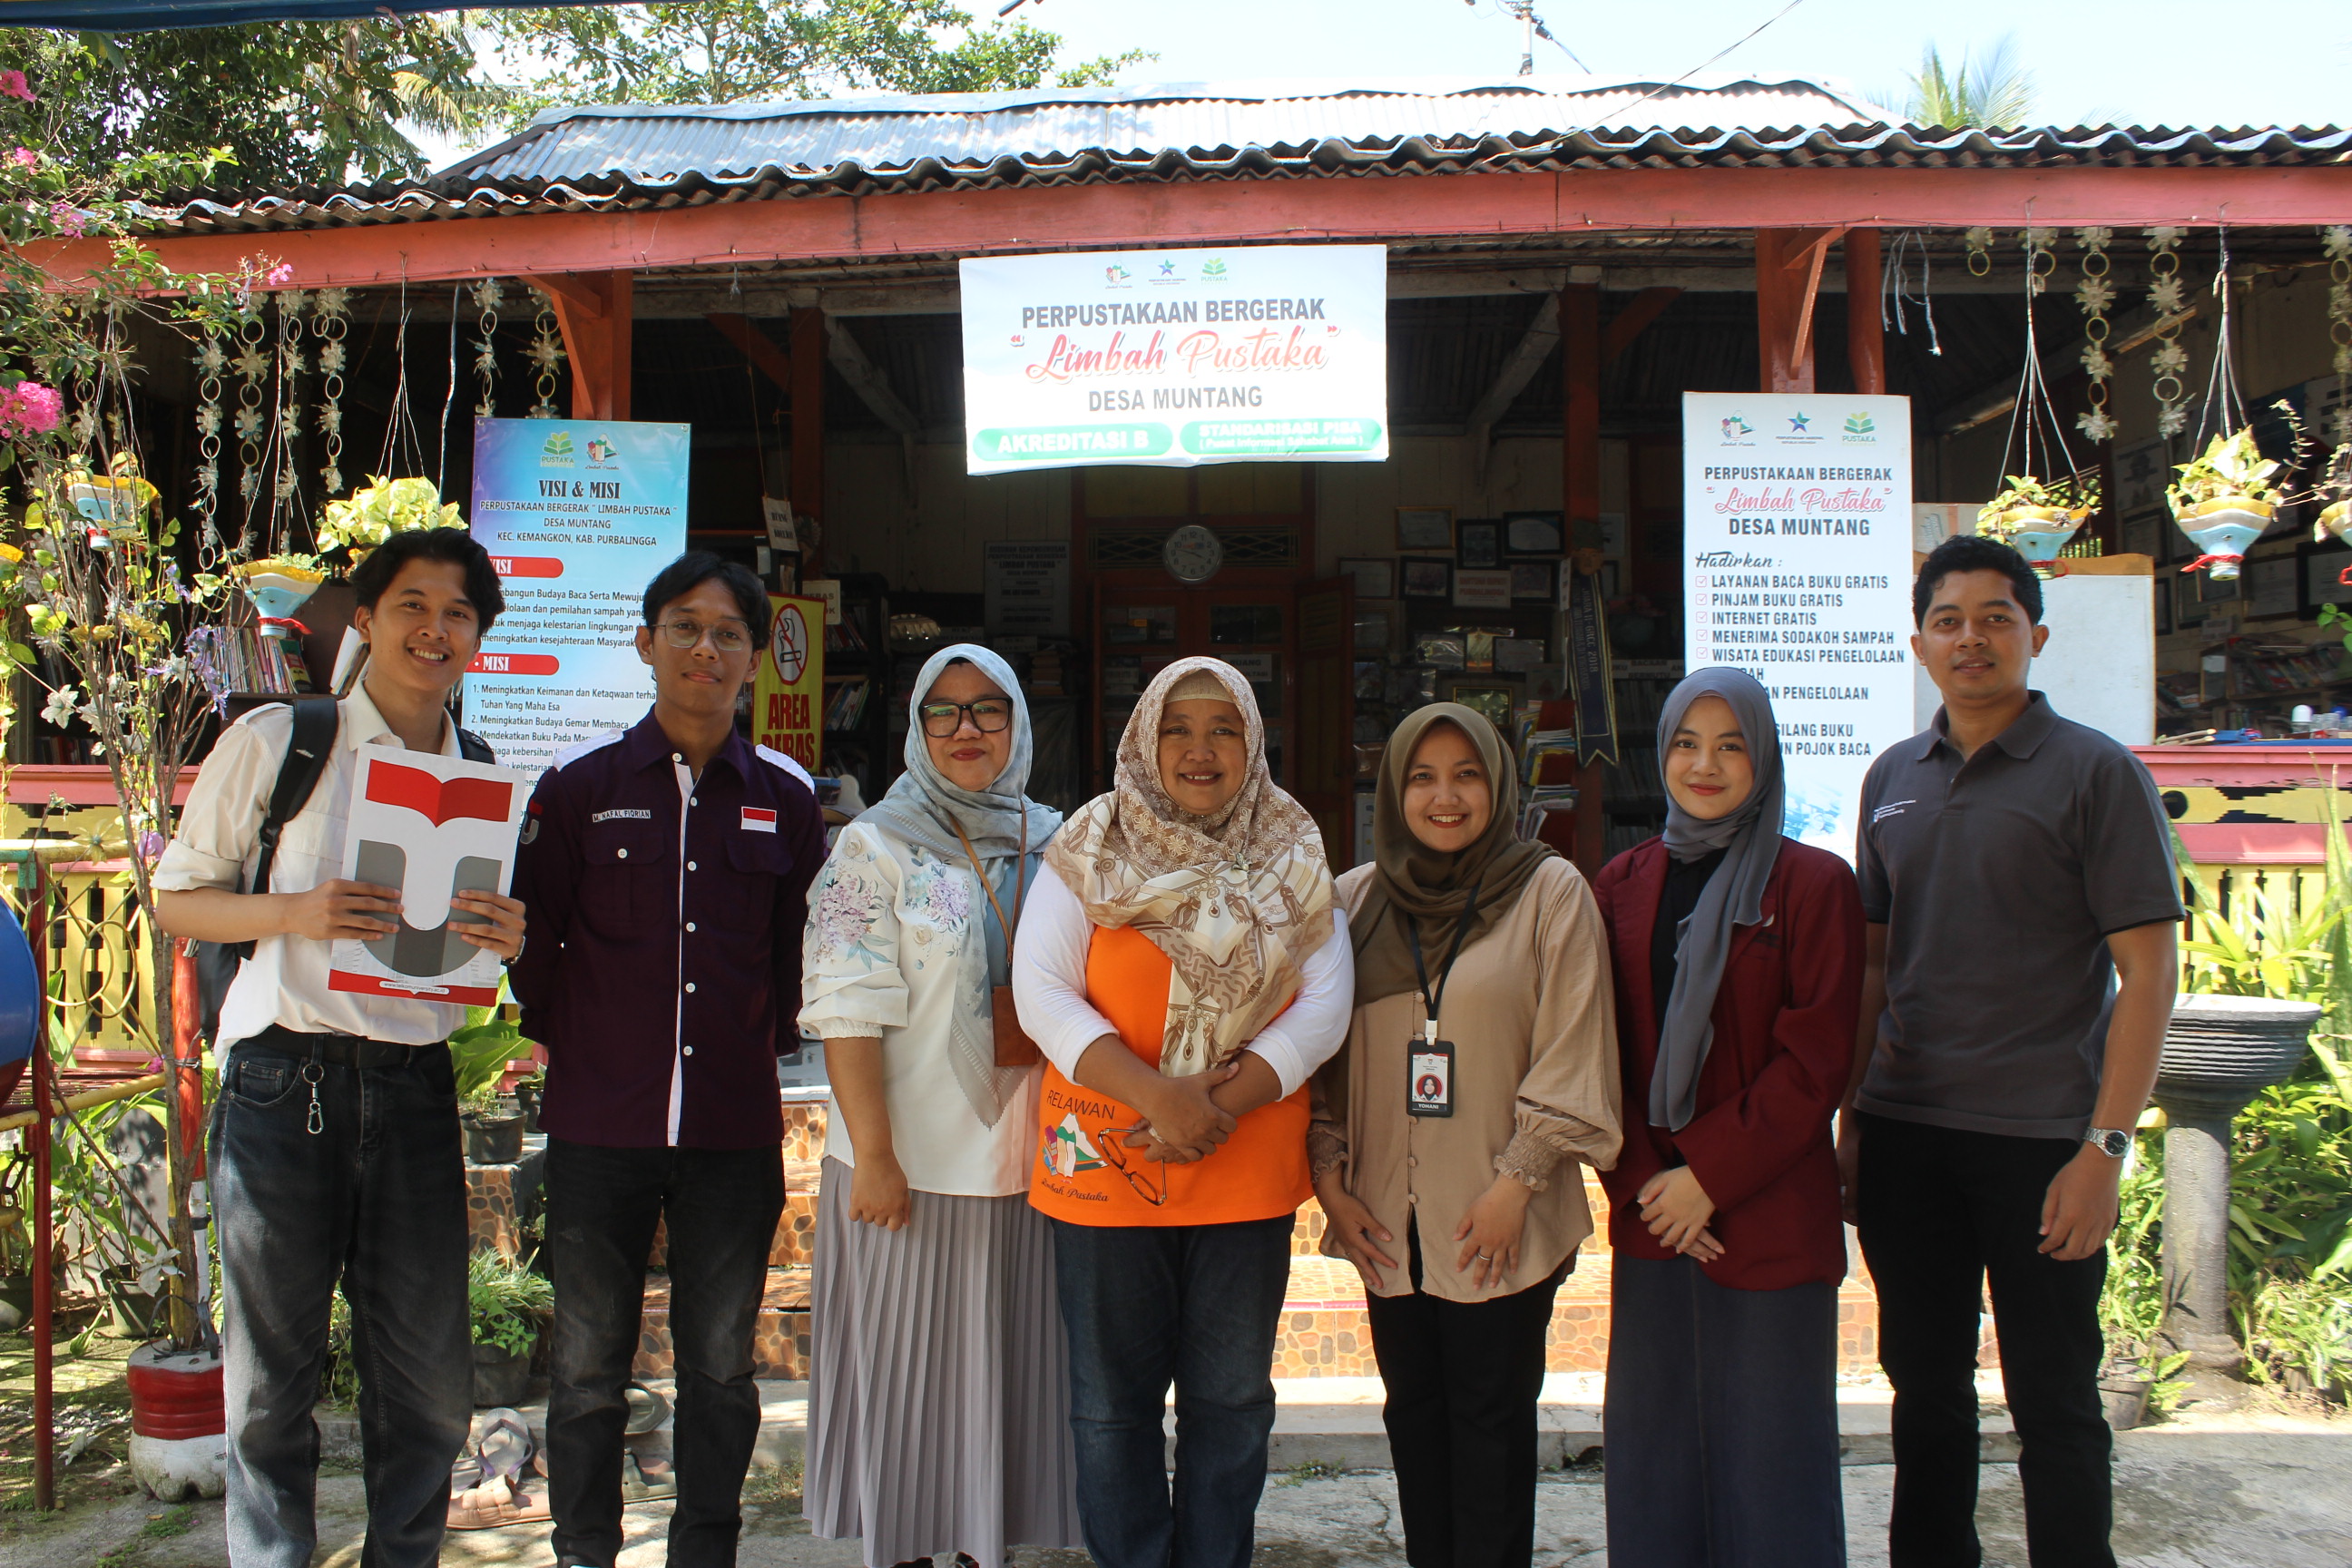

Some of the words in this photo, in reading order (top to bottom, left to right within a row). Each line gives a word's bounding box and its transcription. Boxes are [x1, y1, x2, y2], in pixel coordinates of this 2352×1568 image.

[1023, 301, 1198, 328] PERPUSTAKAAN
[1205, 299, 1325, 322] BERGERAK
[1089, 389, 1145, 412] DESA
[1153, 386, 1262, 410] MUNTANG
[1199, 422, 1319, 436] STANDARISASI
[1323, 421, 1362, 434] PISA
[998, 431, 1127, 453] AKREDITASI
[1133, 430, 1149, 448] B
[542, 456, 574, 464] PUSTAKA
[1704, 466, 1815, 480] PERPUSTAKAAN
[1819, 467, 1893, 481] BERGERAK
[539, 480, 567, 497] VISI
[572, 481, 584, 497] &
[589, 482, 621, 499] MISI
[480, 501, 544, 512] PERPUSTAKAAN
[546, 503, 590, 514] BERGERAK
[598, 504, 631, 514] LIMBAH
[633, 505, 671, 516] PUSTAKA
[544, 517, 565, 527] DESA
[567, 519, 611, 529] MUNTANG
[1729, 518, 1776, 535] DESA
[1781, 518, 1870, 535] MUNTANG
[497, 532, 514, 542] KEC.
[517, 533, 573, 544] KEMANGKON,
[575, 534, 595, 544] KAB.
[597, 534, 657, 545] PURBALINGGA
[1695, 551, 1773, 569] Hadirkan
[1711, 574, 1769, 588] LAYANAN
[1772, 575, 1805, 588] BACA
[1808, 575, 1841, 589] BUKU
[1846, 575, 1888, 589] GRATIS
[537, 589, 566, 601] Budaya
[568, 590, 587, 600] Baca
[589, 591, 610, 601] Serta
[1711, 593, 1759, 607] PINJAM
[1763, 593, 1796, 607] BUKU
[1799, 593, 1843, 607] GRATIS
[533, 603, 548, 613] dan
[550, 604, 592, 616] pemilahan
[593, 606, 625, 618] sampah
[626, 609, 645, 620] yang
[1711, 612, 1770, 625] INTERNET
[1773, 612, 1818, 626] GRATIS
[506, 619, 542, 631] menjaga
[544, 620, 586, 631] kelestarian
[589, 621, 634, 634] lingkungan
[1582, 588, 1593, 614] JUARA
[1588, 651, 1599, 673] 2018
[540, 634, 595, 646] kesejahteraan
[1712, 631, 1779, 644] MENERIMA
[1782, 631, 1839, 644] SODAKOH
[1843, 632, 1895, 645] SAMPAH
[483, 655, 510, 671] MISI
[1712, 649, 1759, 662] WISATA
[1763, 649, 1816, 662] EDUKASI
[1819, 650, 1905, 663] PENGELOLAAN
[473, 684, 479, 693] 1.
[481, 684, 535, 697] Meningkatkan
[536, 686, 574, 697] Keimanan
[575, 687, 591, 697] dan
[593, 688, 634, 701] Ketaqwaan
[1783, 687, 1869, 700] PENGELOLAAN
[481, 699, 504, 710] Tuhan
[505, 701, 524, 711] Yang
[524, 701, 546, 710] Maha
[548, 702, 561, 711] Esa
[768, 693, 811, 730] AREA
[471, 715, 478, 724] 2.
[480, 715, 534, 727] Meningkatkan
[535, 717, 564, 729] Budaya
[564, 718, 591, 728] Gemar
[592, 719, 629, 730] Membaca
[479, 730, 530, 741] Mendekatkan
[532, 731, 552, 741] Buku
[553, 732, 572, 742] Pada
[1820, 724, 1854, 737] BUKU
[512, 747, 554, 757] kebersihan
[1796, 742, 1836, 756] POJOK
[1839, 743, 1871, 756] BACA
[1046, 1089, 1115, 1120] RELAWAN
[1066, 1188, 1109, 1202] Pustaka
